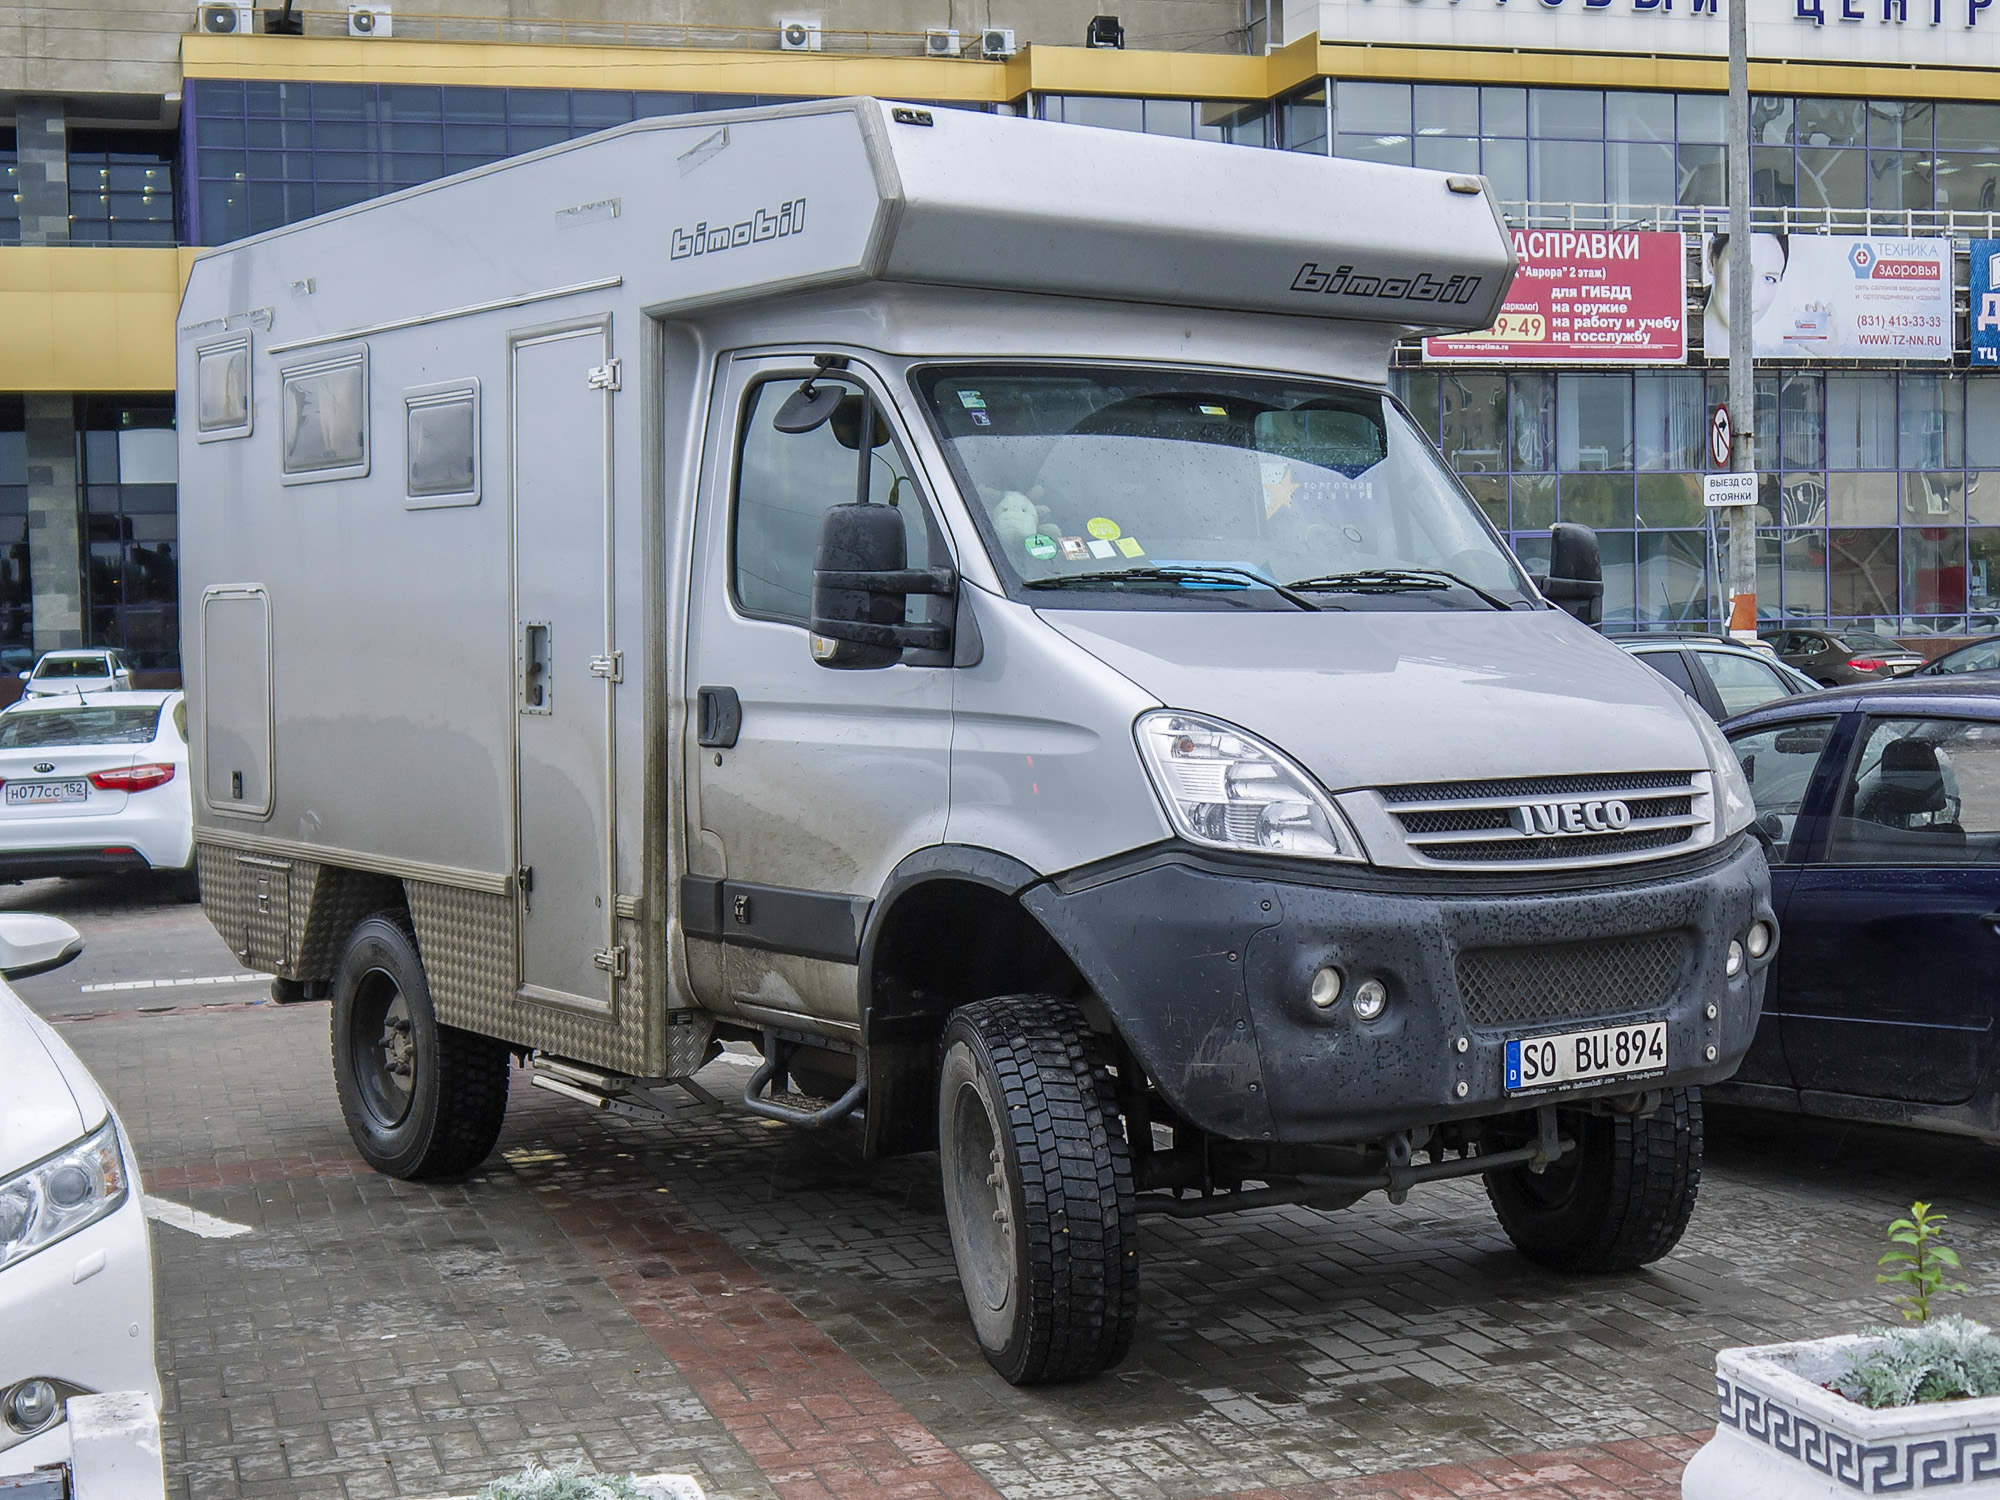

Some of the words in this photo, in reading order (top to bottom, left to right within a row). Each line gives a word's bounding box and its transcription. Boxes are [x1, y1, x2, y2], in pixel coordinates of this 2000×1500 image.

[670, 198, 806, 261] bimobil
[1509, 231, 1640, 262] ДСПРАВКИ
[1877, 243, 1939, 257] ТЕХНИКА
[1569, 267, 1576, 277] 2
[1577, 267, 1607, 280] этаж)
[1879, 265, 1938, 278] здоровья
[1290, 263, 1482, 304] bimobil
[1551, 287, 1578, 299] для
[1581, 285, 1632, 300] ГИБДД
[1552, 303, 1570, 313] на
[1573, 302, 1628, 315] оружие
[1552, 317, 1570, 328] на
[1573, 315, 1623, 330] работу
[1626, 319, 1635, 328] и
[1638, 316, 1680, 331] учебу
[1857, 315, 1885, 328] (831)
[1888, 315, 1942, 327] 413-33-33
[1552, 331, 1571, 342] на
[1573, 329, 1651, 344] госслужбу
[1858, 334, 1942, 346] WWW.TZ-NN.RU
[1710, 478, 1739, 487] ВЫЕЗД
[1741, 478, 1753, 486] СО
[1709, 492, 1751, 502] СТОЯНКИ
[36, 762, 52, 771] KIA
[63, 783, 83, 793] 152
[1512, 800, 1631, 835] IVECO
[1523, 1041, 1556, 1080] SO
[1615, 1026, 1664, 1067] 894
[1509, 1071, 1517, 1081] D
